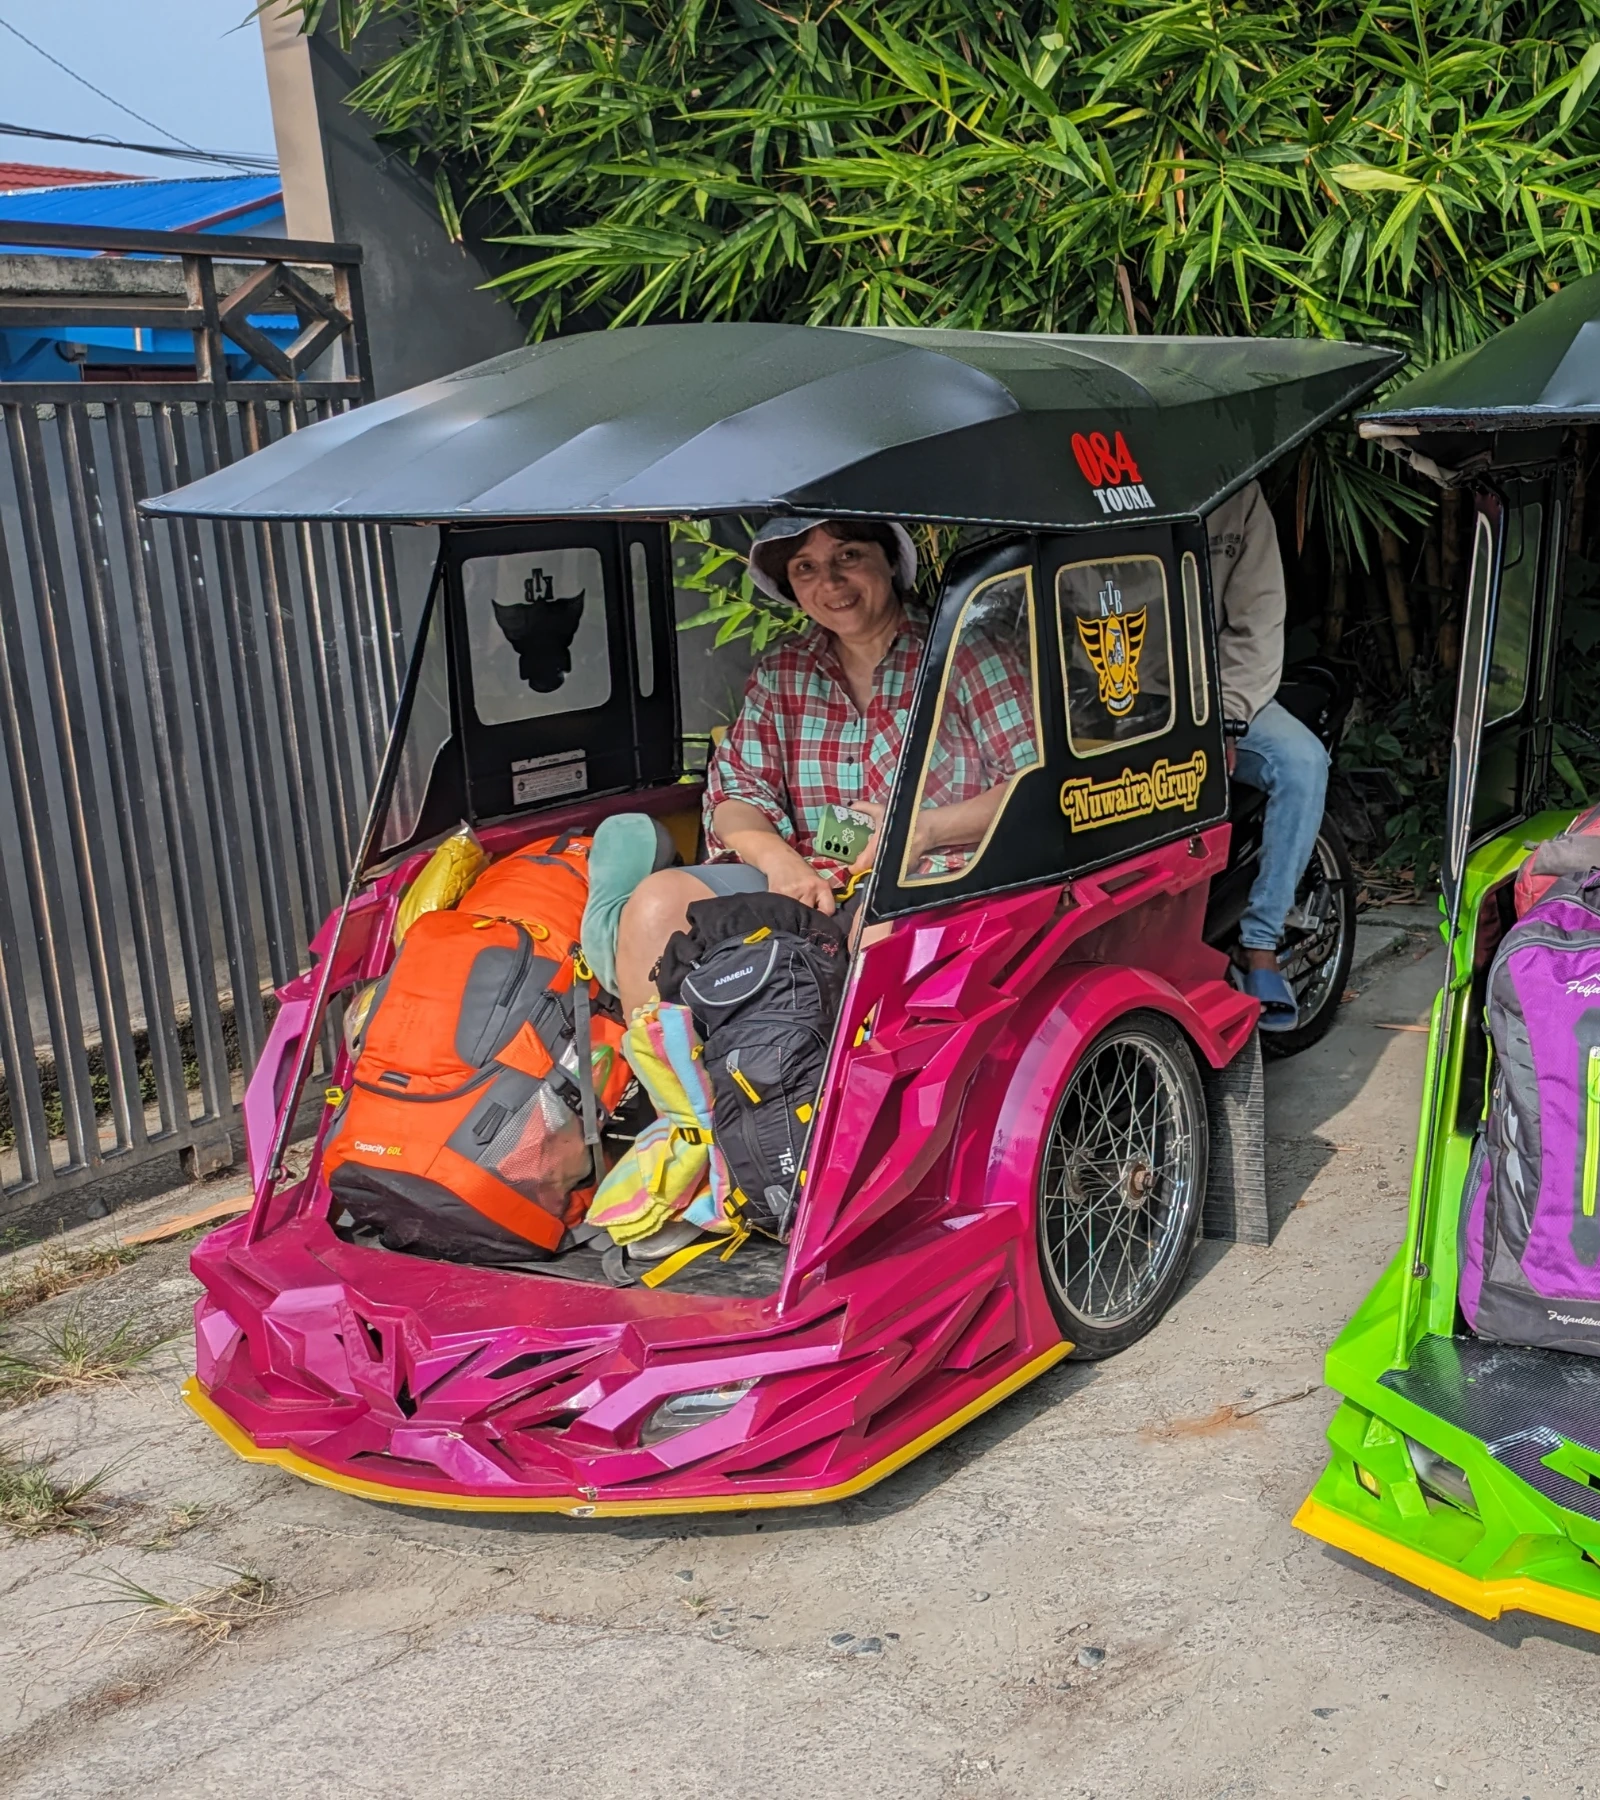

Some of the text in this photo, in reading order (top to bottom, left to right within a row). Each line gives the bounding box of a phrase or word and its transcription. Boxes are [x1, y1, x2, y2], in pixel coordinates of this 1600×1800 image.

[1071, 431, 1142, 487] 084
[1092, 484, 1156, 514] TOUNA
[1099, 580, 1123, 617] KTB
[713, 965, 754, 988] ANMEILU
[354, 1140, 403, 1157] Capacity 60L
